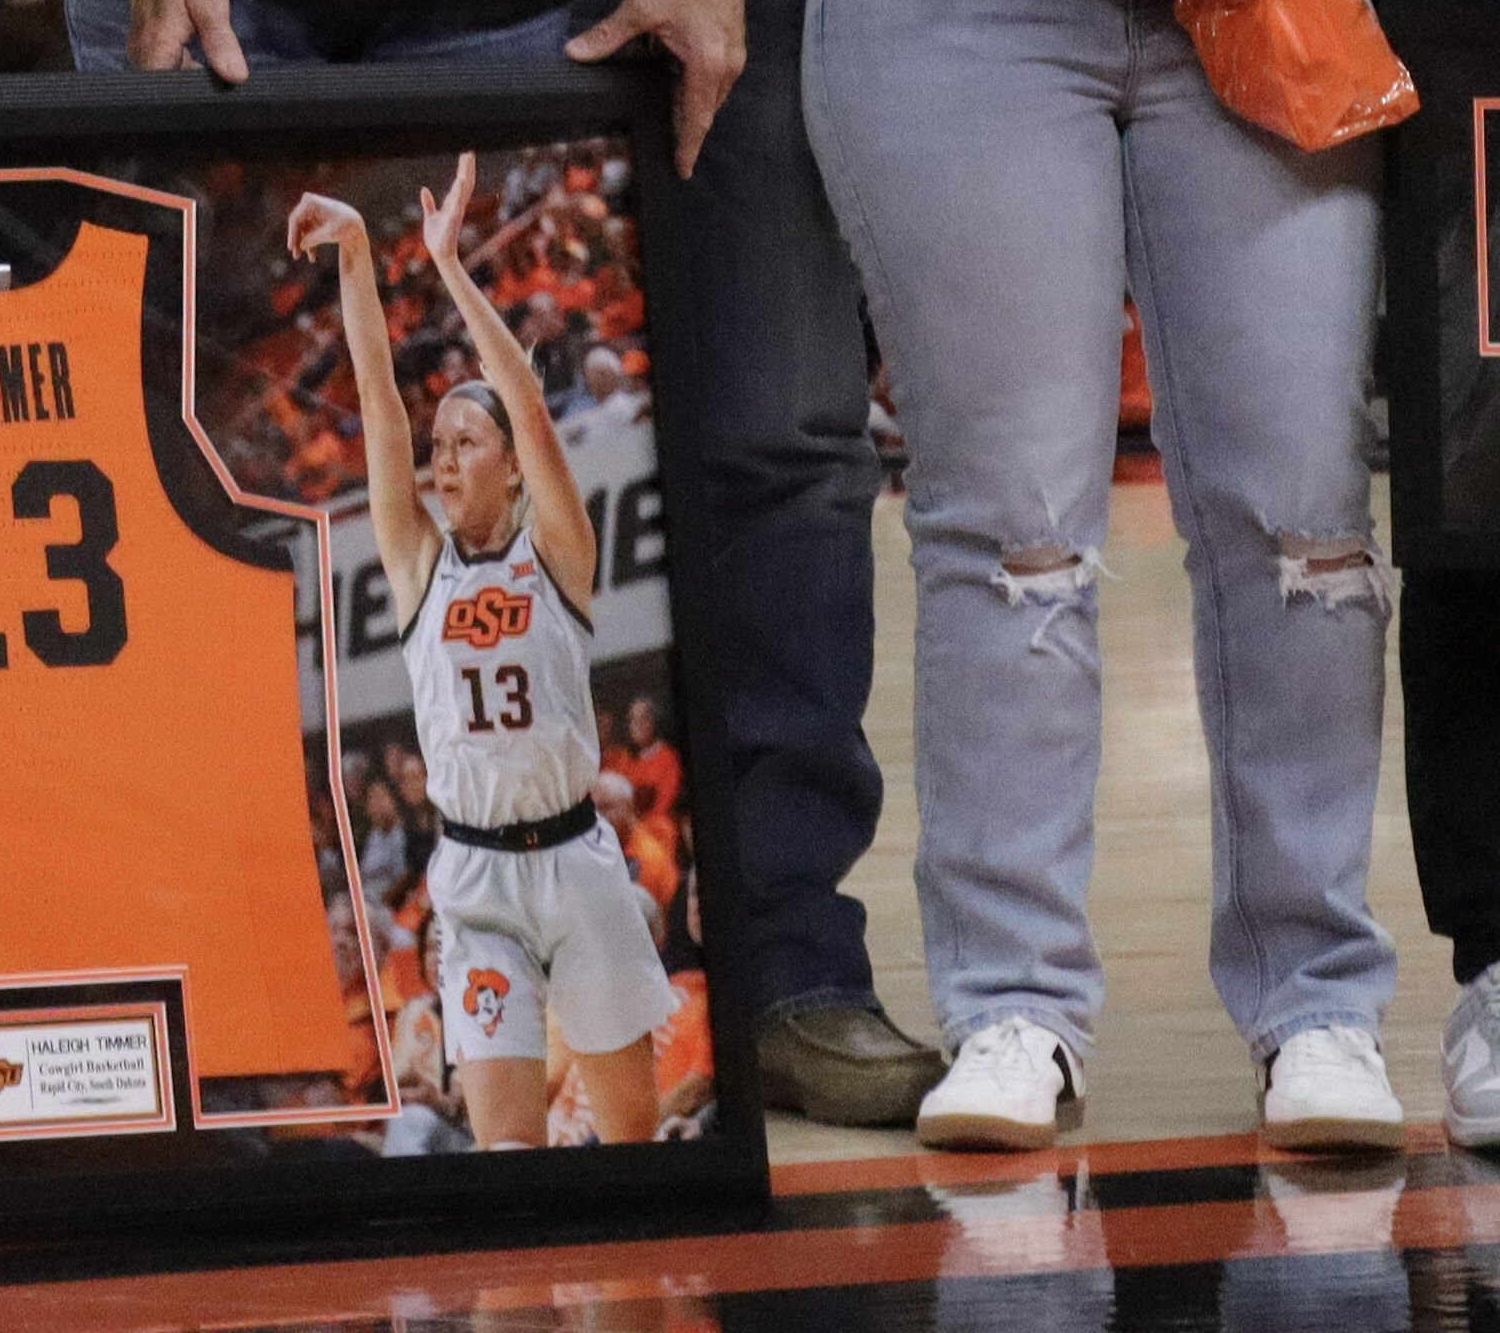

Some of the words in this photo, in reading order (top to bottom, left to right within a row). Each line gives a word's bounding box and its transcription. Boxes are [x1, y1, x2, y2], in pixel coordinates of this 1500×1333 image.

[442, 586, 534, 650] OSU
[461, 664, 534, 733] 13
[31, 1040, 90, 1056] HALEIGH
[97, 1036, 148, 1052] TIMMER
[39, 1061, 86, 1077] Cowgirl
[87, 1057, 145, 1073] Basketball
[40, 1081, 66, 1097] Rapid
